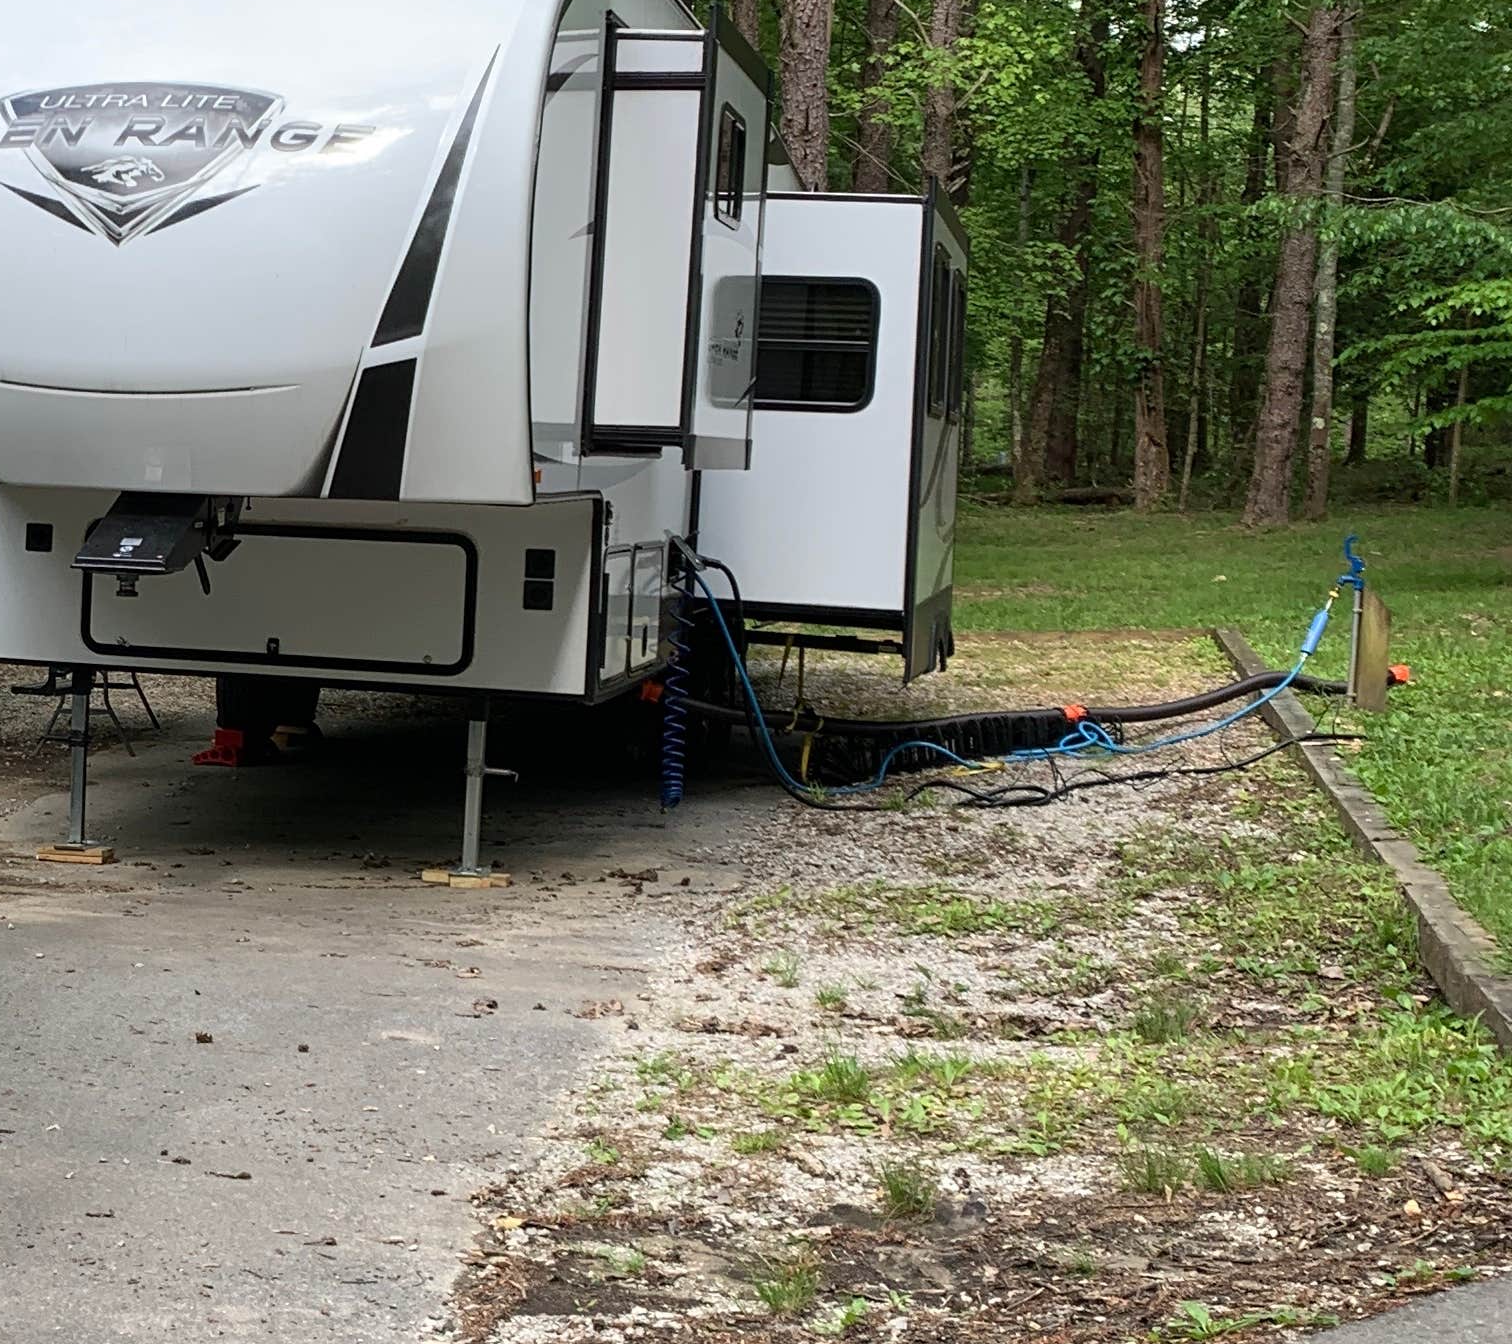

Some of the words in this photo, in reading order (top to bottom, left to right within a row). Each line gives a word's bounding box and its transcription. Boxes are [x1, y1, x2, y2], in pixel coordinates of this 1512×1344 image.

[39, 93, 149, 111] ULTRA
[160, 92, 241, 111] LITE
[113, 114, 377, 155] RANGE
